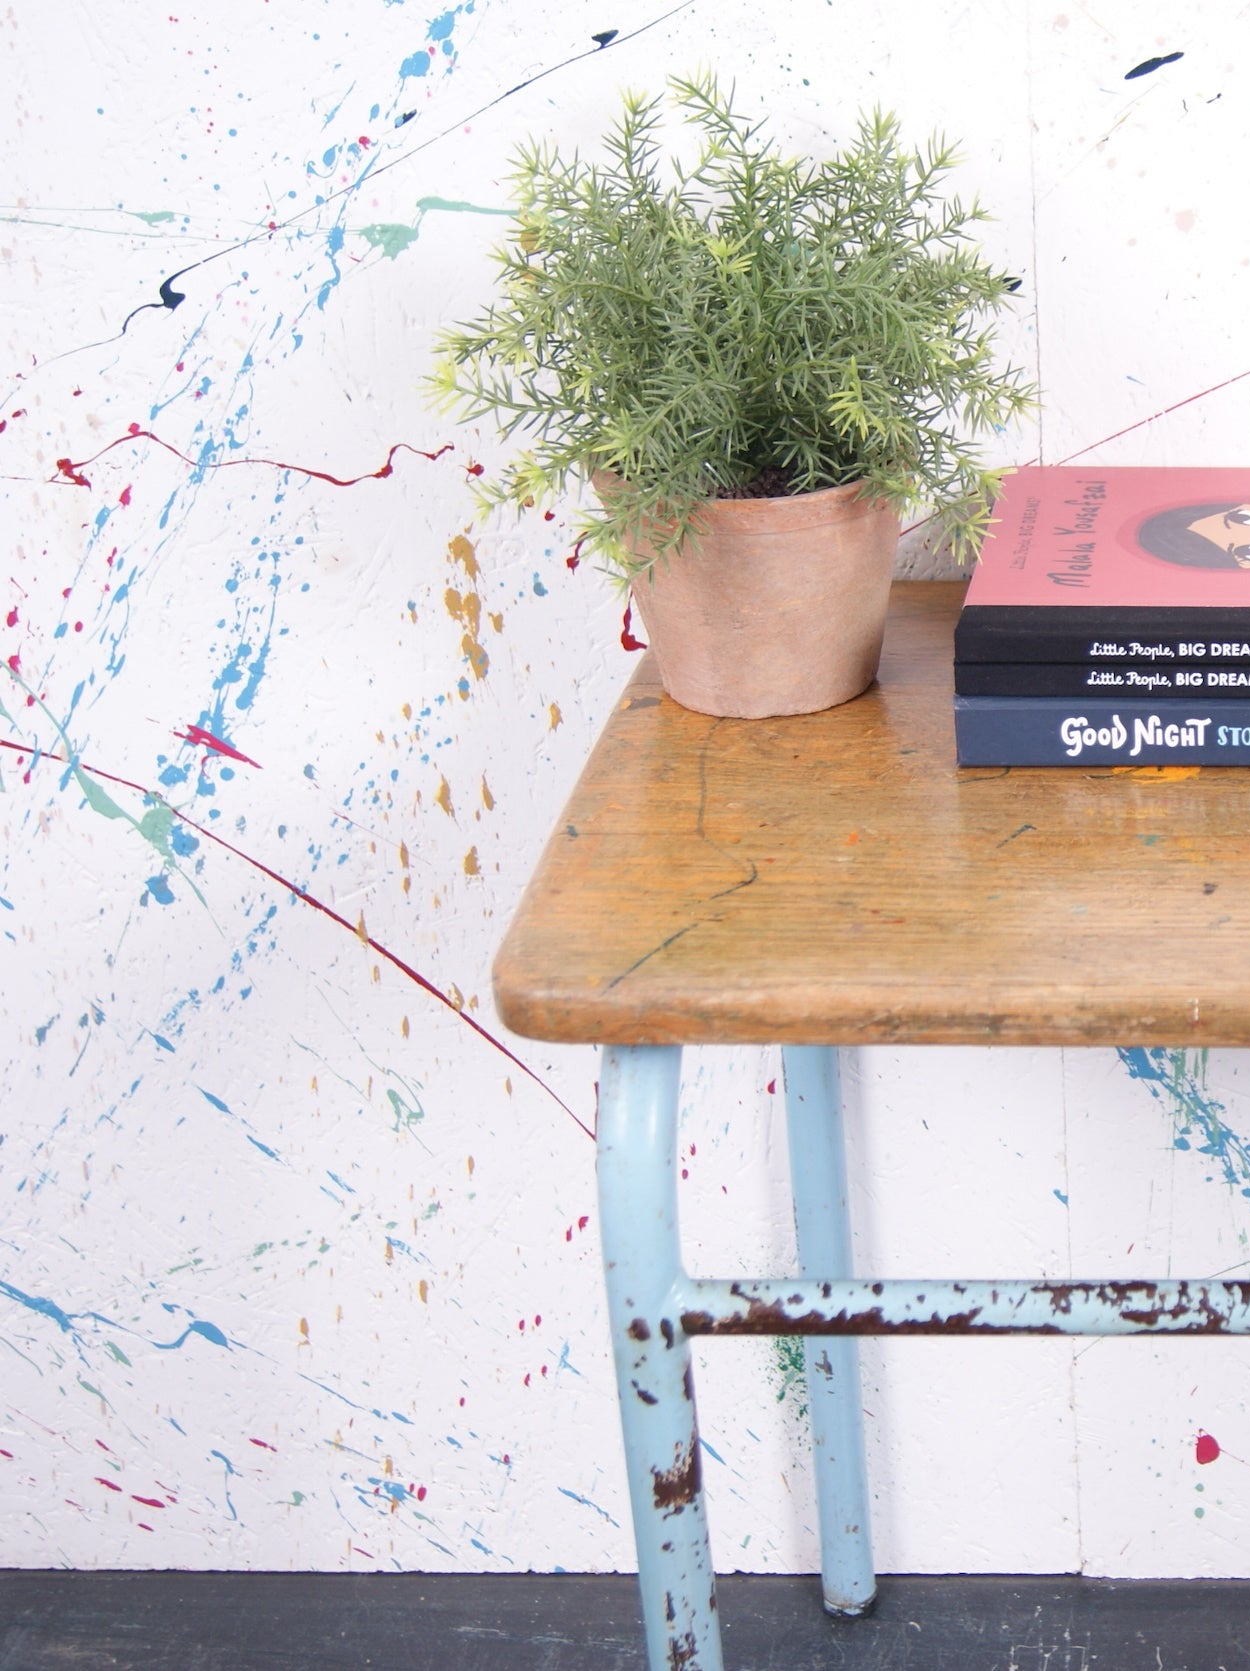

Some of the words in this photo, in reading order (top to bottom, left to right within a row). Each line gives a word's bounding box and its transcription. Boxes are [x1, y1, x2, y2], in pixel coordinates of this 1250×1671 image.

[1052, 480, 1107, 536] Yousafzai
[1046, 542, 1096, 588] Malala
[1090, 642, 1127, 657] Little
[1129, 642, 1175, 660] People,
[1178, 643, 1206, 657] BIG
[1087, 671, 1124, 686] Little
[1126, 672, 1172, 691] People,
[1175, 673, 1203, 686] BIG
